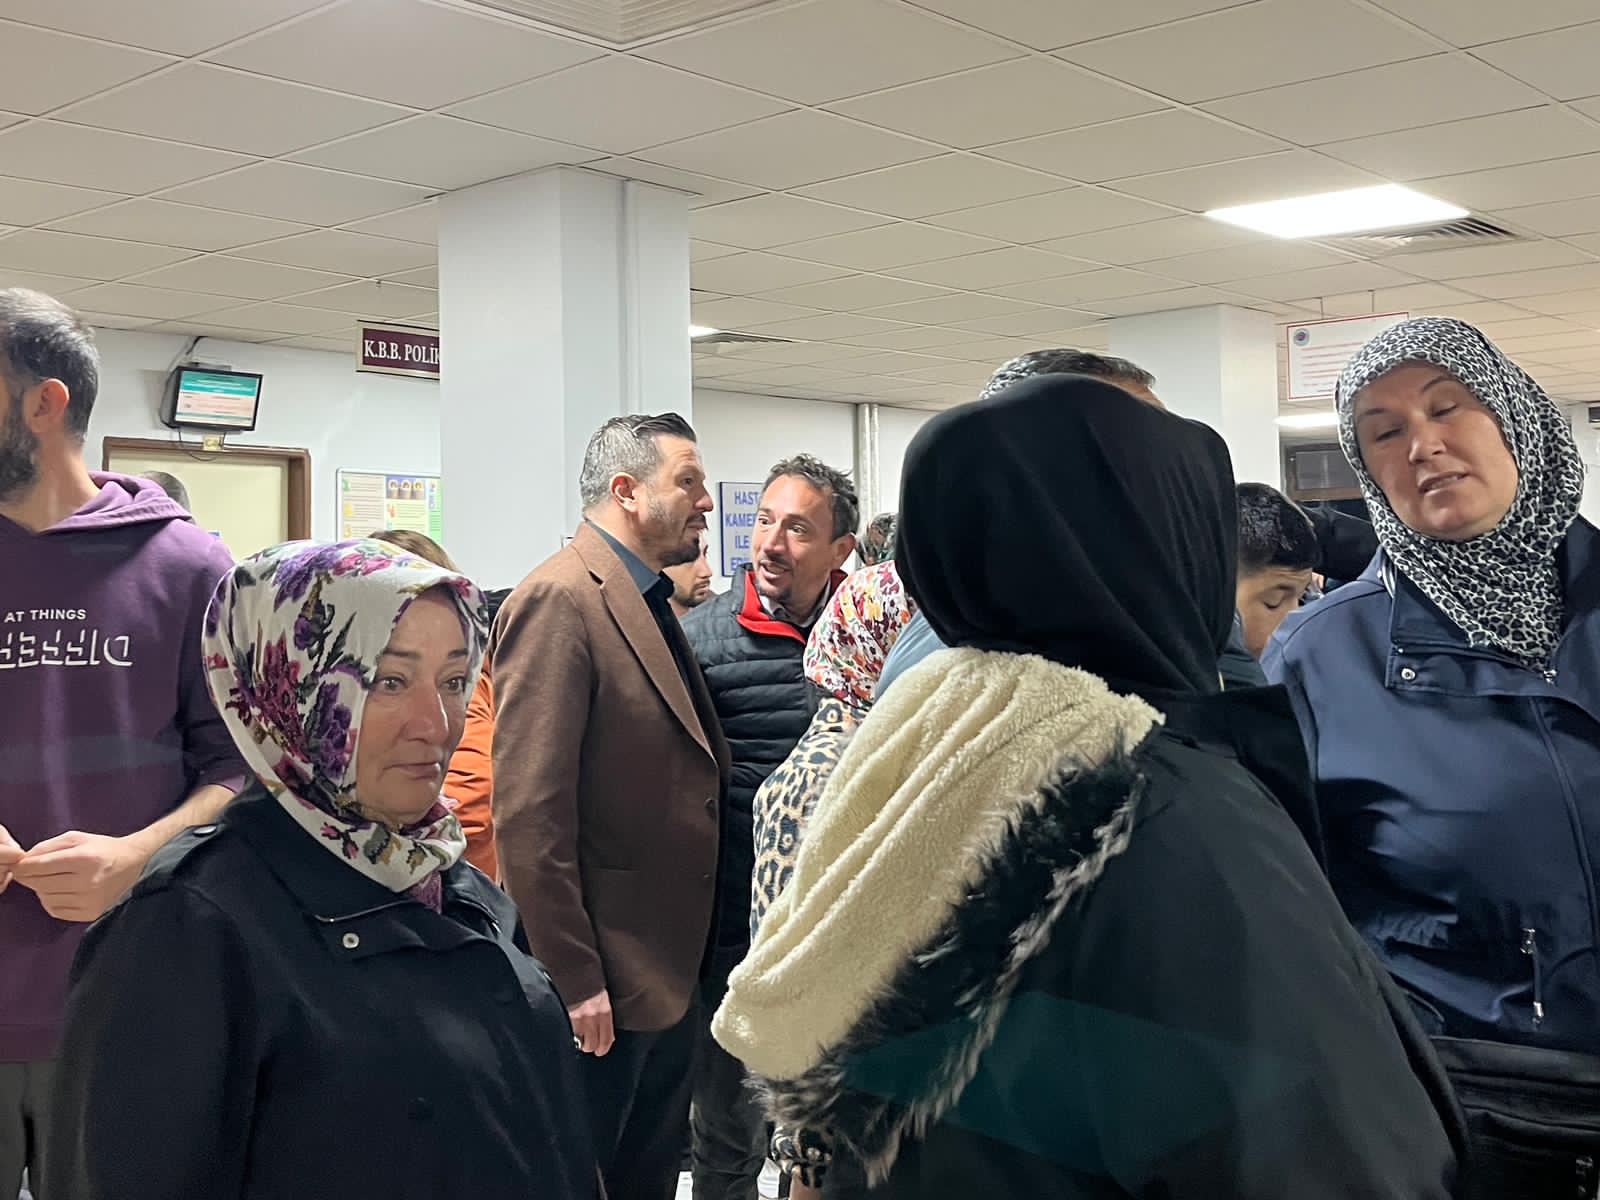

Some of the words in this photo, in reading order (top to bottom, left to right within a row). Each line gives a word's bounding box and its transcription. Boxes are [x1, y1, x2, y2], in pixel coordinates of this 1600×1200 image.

[363, 339, 402, 361] K.B.B.
[3, 611, 25, 622] AT
[29, 608, 87, 620] THINGS
